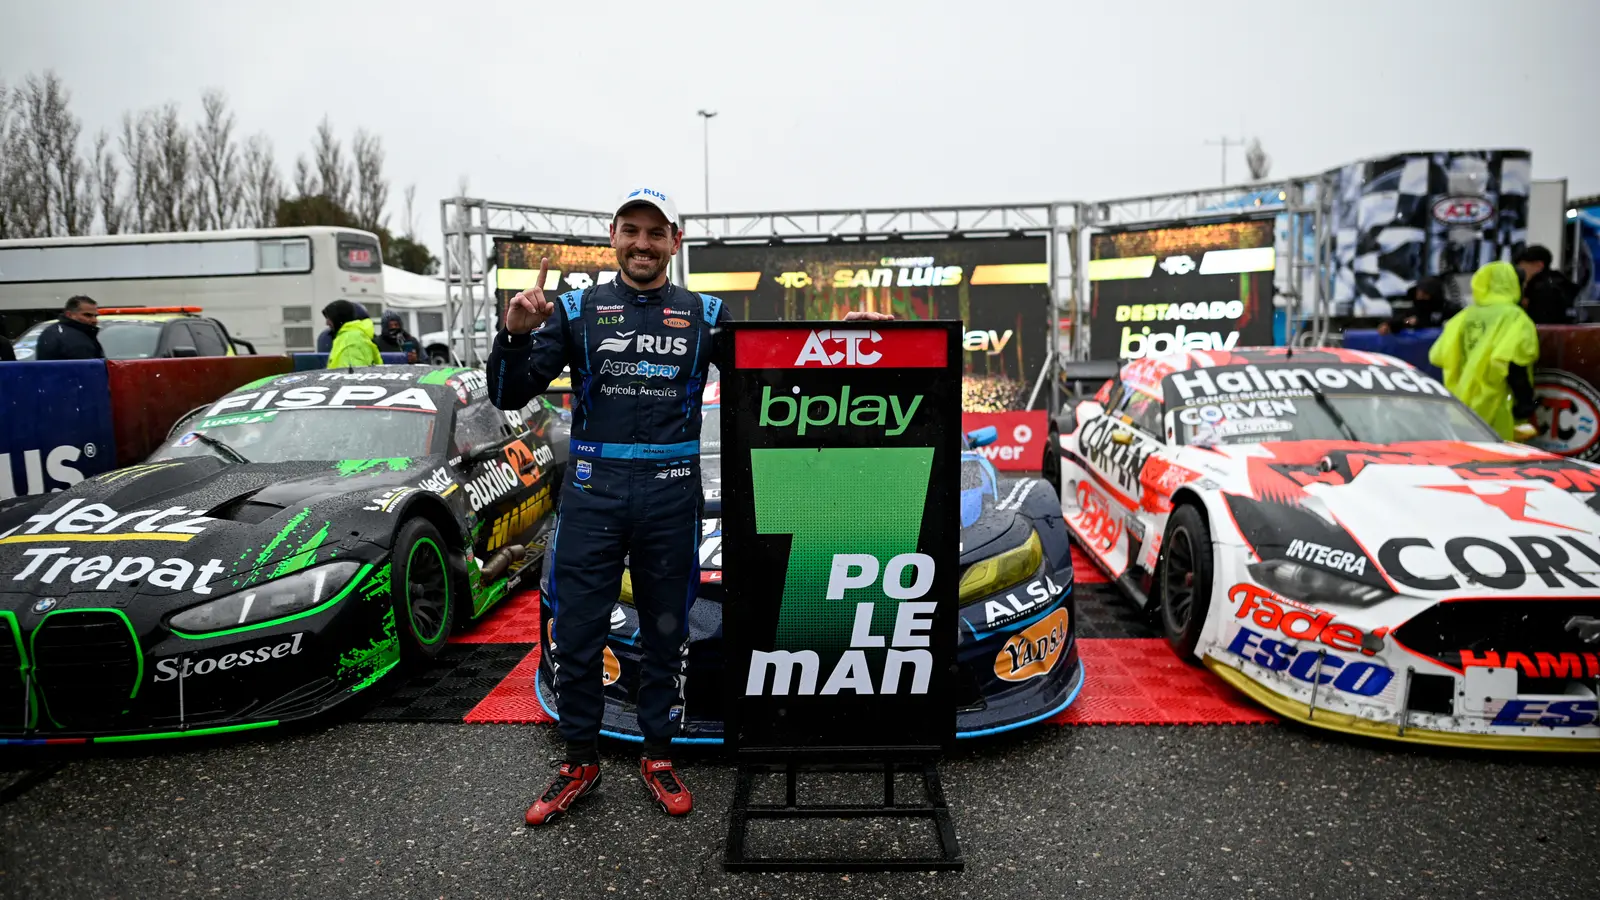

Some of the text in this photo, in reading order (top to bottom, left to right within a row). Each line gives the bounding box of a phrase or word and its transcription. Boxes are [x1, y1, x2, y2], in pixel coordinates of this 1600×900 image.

[643, 188, 666, 201] RUS
[897, 266, 963, 287] LUIS
[596, 304, 625, 312] Wander
[1115, 300, 1244, 322] DESTACADO
[636, 334, 688, 356] RUS
[794, 329, 883, 366] ACTC
[317, 371, 414, 382] Trepat
[600, 359, 680, 379] AgroSpray
[1171, 364, 1450, 399] Halmovich
[204, 385, 438, 417] FISPA
[600, 384, 677, 398] Agrícola Arrecifes
[200, 415, 250, 428] Lucas
[758, 385, 924, 436] bplay
[1180, 398, 1297, 425] CORVEN
[1531, 396, 1579, 441] CTC
[577, 445, 597, 453] HRX
[418, 466, 454, 494] Hertz
[670, 468, 691, 478] RUS
[0, 498, 218, 541] Hertz
[12, 547, 226, 595] Trepat
[1285, 538, 1367, 577] INTEGRA
[825, 553, 936, 600] PO
[850, 601, 938, 647] LE
[153, 632, 304, 683] Stoessel
[1003, 618, 1066, 676] YADSA
[1227, 626, 1395, 697] ESCO
